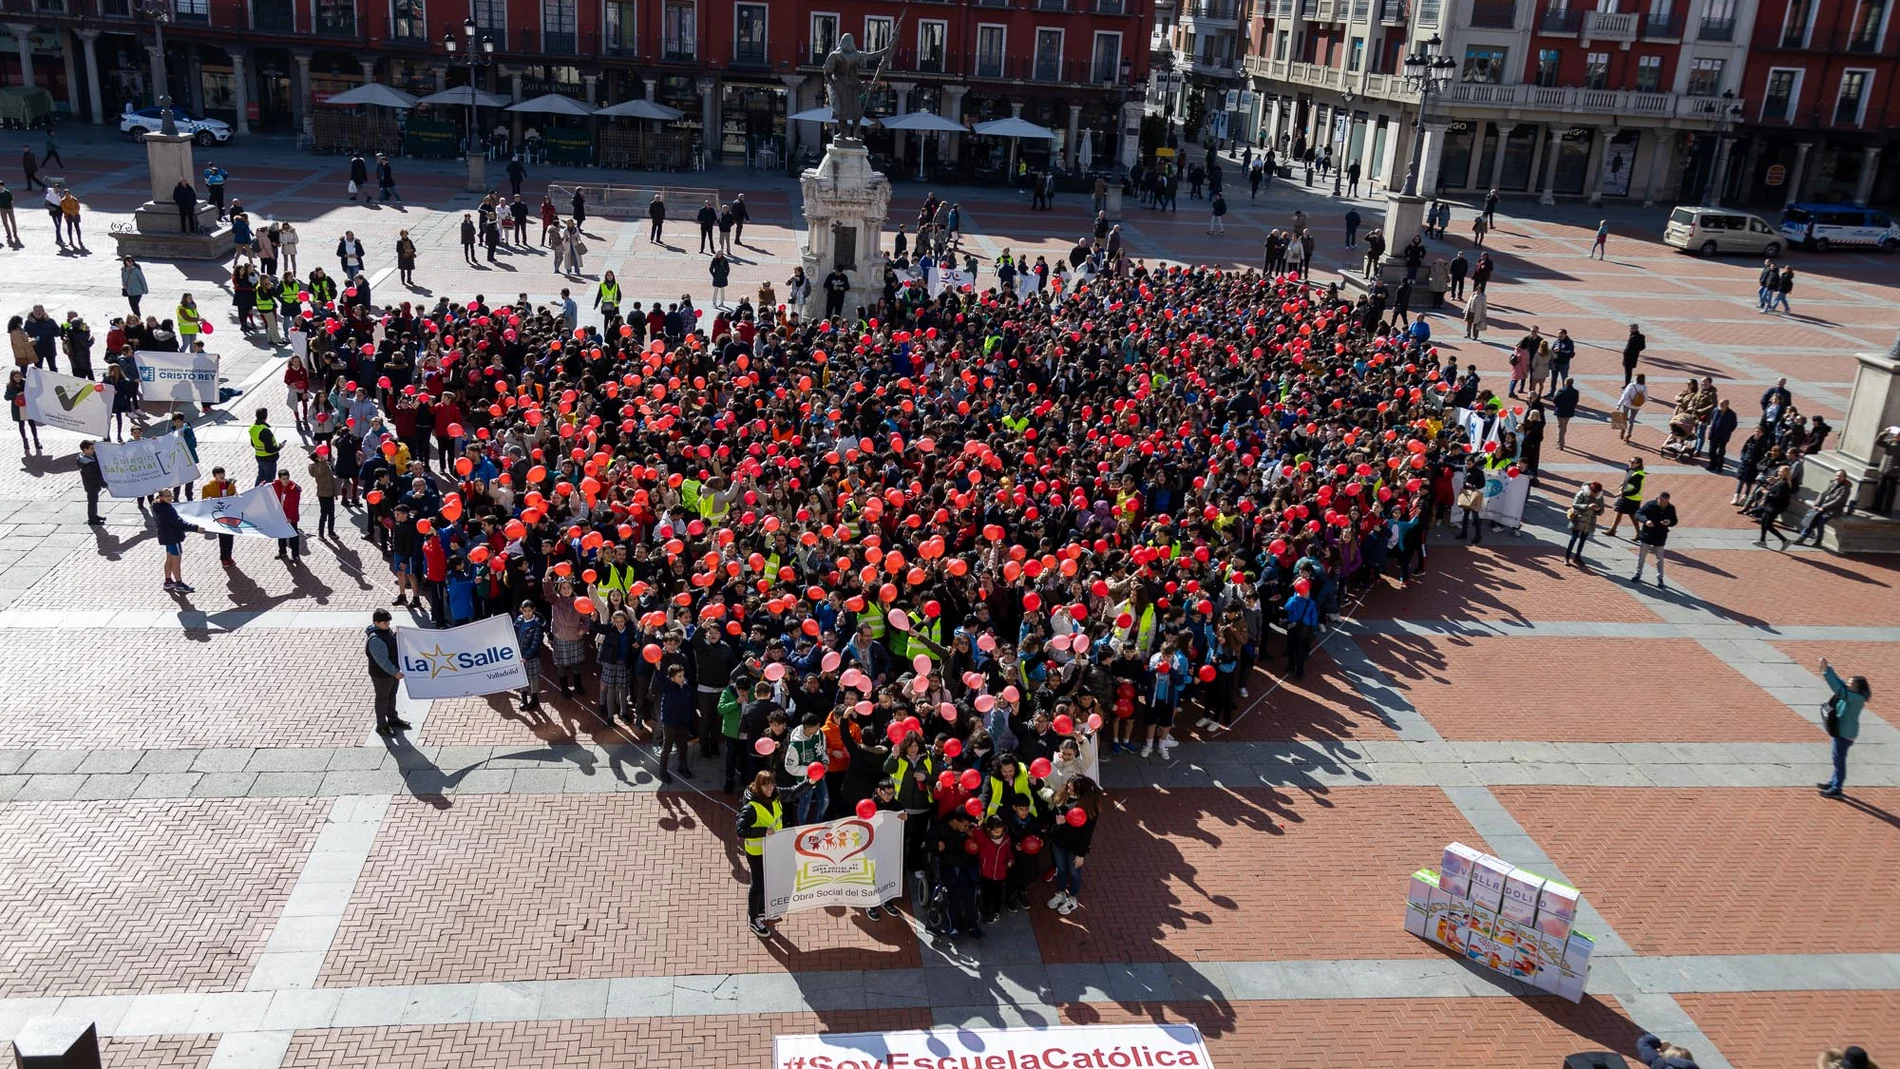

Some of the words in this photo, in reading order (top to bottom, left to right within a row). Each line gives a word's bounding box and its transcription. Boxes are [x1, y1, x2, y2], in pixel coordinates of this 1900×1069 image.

[159, 372, 196, 381] CRISTO
[198, 373, 216, 381] REY
[113, 454, 154, 465] Colegio
[404, 656, 429, 672] La
[458, 646, 513, 669] Salle
[486, 667, 519, 681] Valladolid
[770, 896, 790, 908] CEE
[792, 892, 814, 902] Obra
[816, 888, 843, 898] Social
[845, 888, 859, 897] del
[861, 880, 896, 898] Santuario
